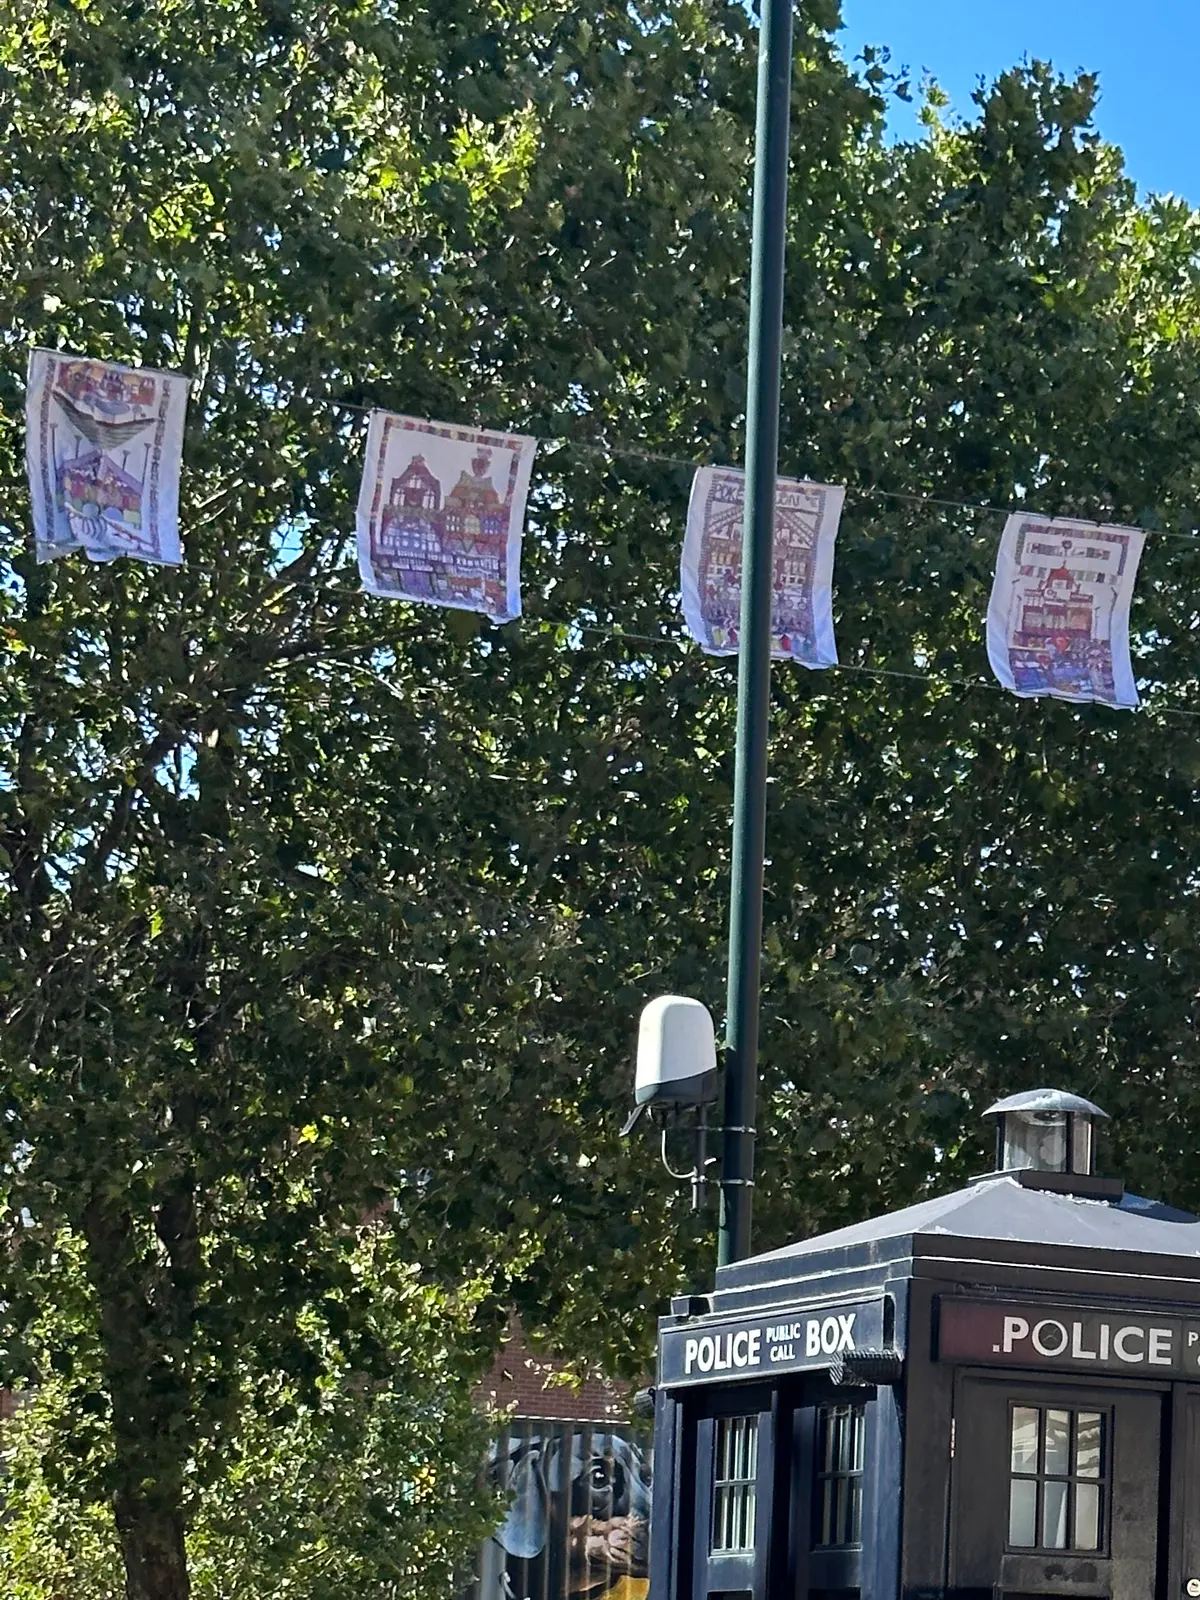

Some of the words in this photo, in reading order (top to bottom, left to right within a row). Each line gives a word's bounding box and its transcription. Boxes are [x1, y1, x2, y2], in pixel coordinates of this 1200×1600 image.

[766, 1323, 801, 1343] PUBLIC
[806, 1313, 856, 1357] BOX
[685, 1328, 761, 1374] POLICE
[770, 1344, 795, 1362] CALL
